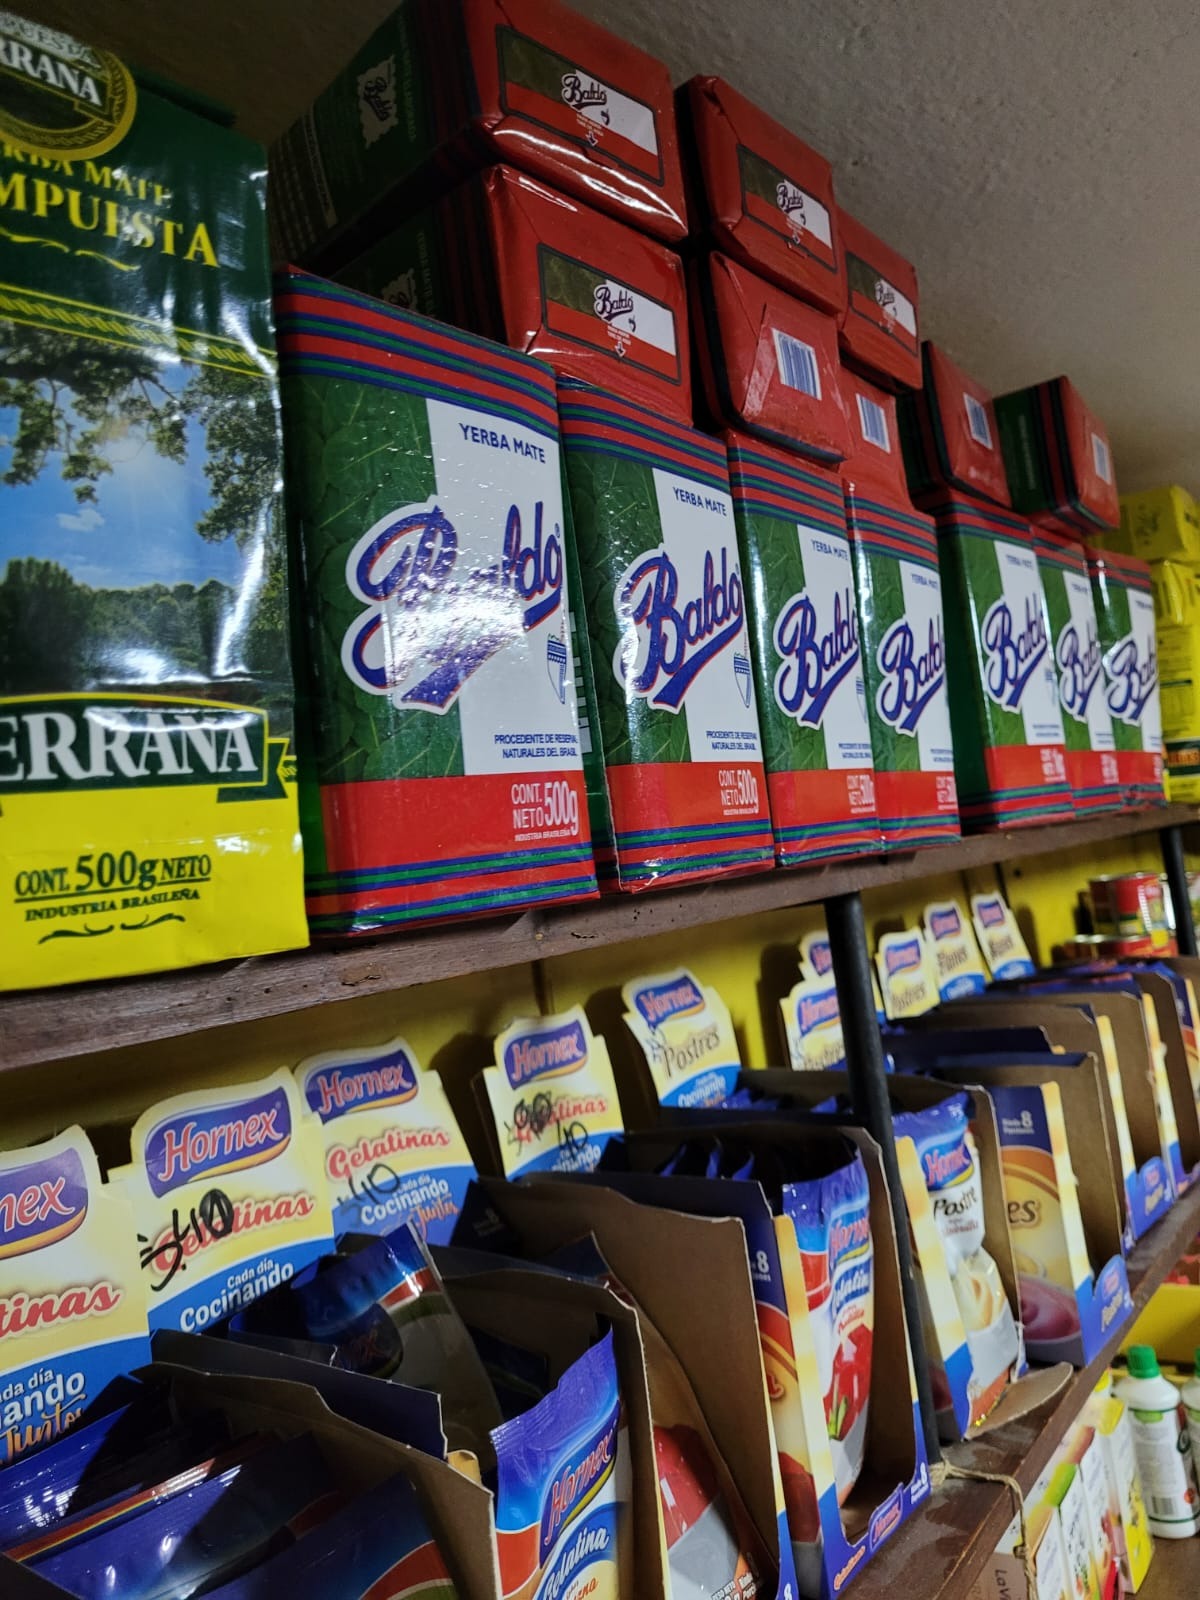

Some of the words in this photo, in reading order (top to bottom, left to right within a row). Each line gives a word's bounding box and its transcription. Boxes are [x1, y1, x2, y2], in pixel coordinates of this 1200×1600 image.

[563, 75, 608, 110] Baldo
[596, 287, 634, 320] Baldo
[459, 422, 511, 450] YERBA
[513, 438, 547, 465] MATE
[672, 486, 703, 507] YERBA
[705, 496, 727, 517] MATE
[352, 501, 563, 709] Bldo
[618, 546, 745, 707] Baldo
[880, 615, 945, 733] Bald
[494, 733, 544, 745] PROCEDENTE
[545, 733, 554, 744] DE
[502, 747, 545, 758] NATURALES
[546, 747, 559, 757] DEL
[511, 782, 542, 805] CONT.
[544, 780, 579, 836] 500g
[720, 788, 739, 806] NETO
[512, 806, 544, 829] NETO
[75, 850, 158, 893] 500g
[161, 854, 212, 882] NETO
[25, 899, 118, 922] INDUSTRIA
[121, 888, 200, 911] BRASILEÑA
[512, 1031, 580, 1082] Hornex
[661, 1027, 721, 1080] Postres
[318, 1062, 414, 1115] Hornex
[1021, 1110, 1032, 1129] 8
[158, 1107, 283, 1183] Hornex
[327, 1128, 450, 1184] Gelatinas
[360, 1178, 449, 1226] Cocinando
[227, 1270, 256, 1290] Cada
[256, 1257, 274, 1276] día
[756, 1250, 770, 1274] 8
[179, 1262, 294, 1333] Cocinando
[0, 1383, 24, 1403] da
[28, 1367, 54, 1389] día
[0, 1372, 85, 1430] ando
[543, 1428, 613, 1546] Hornex
